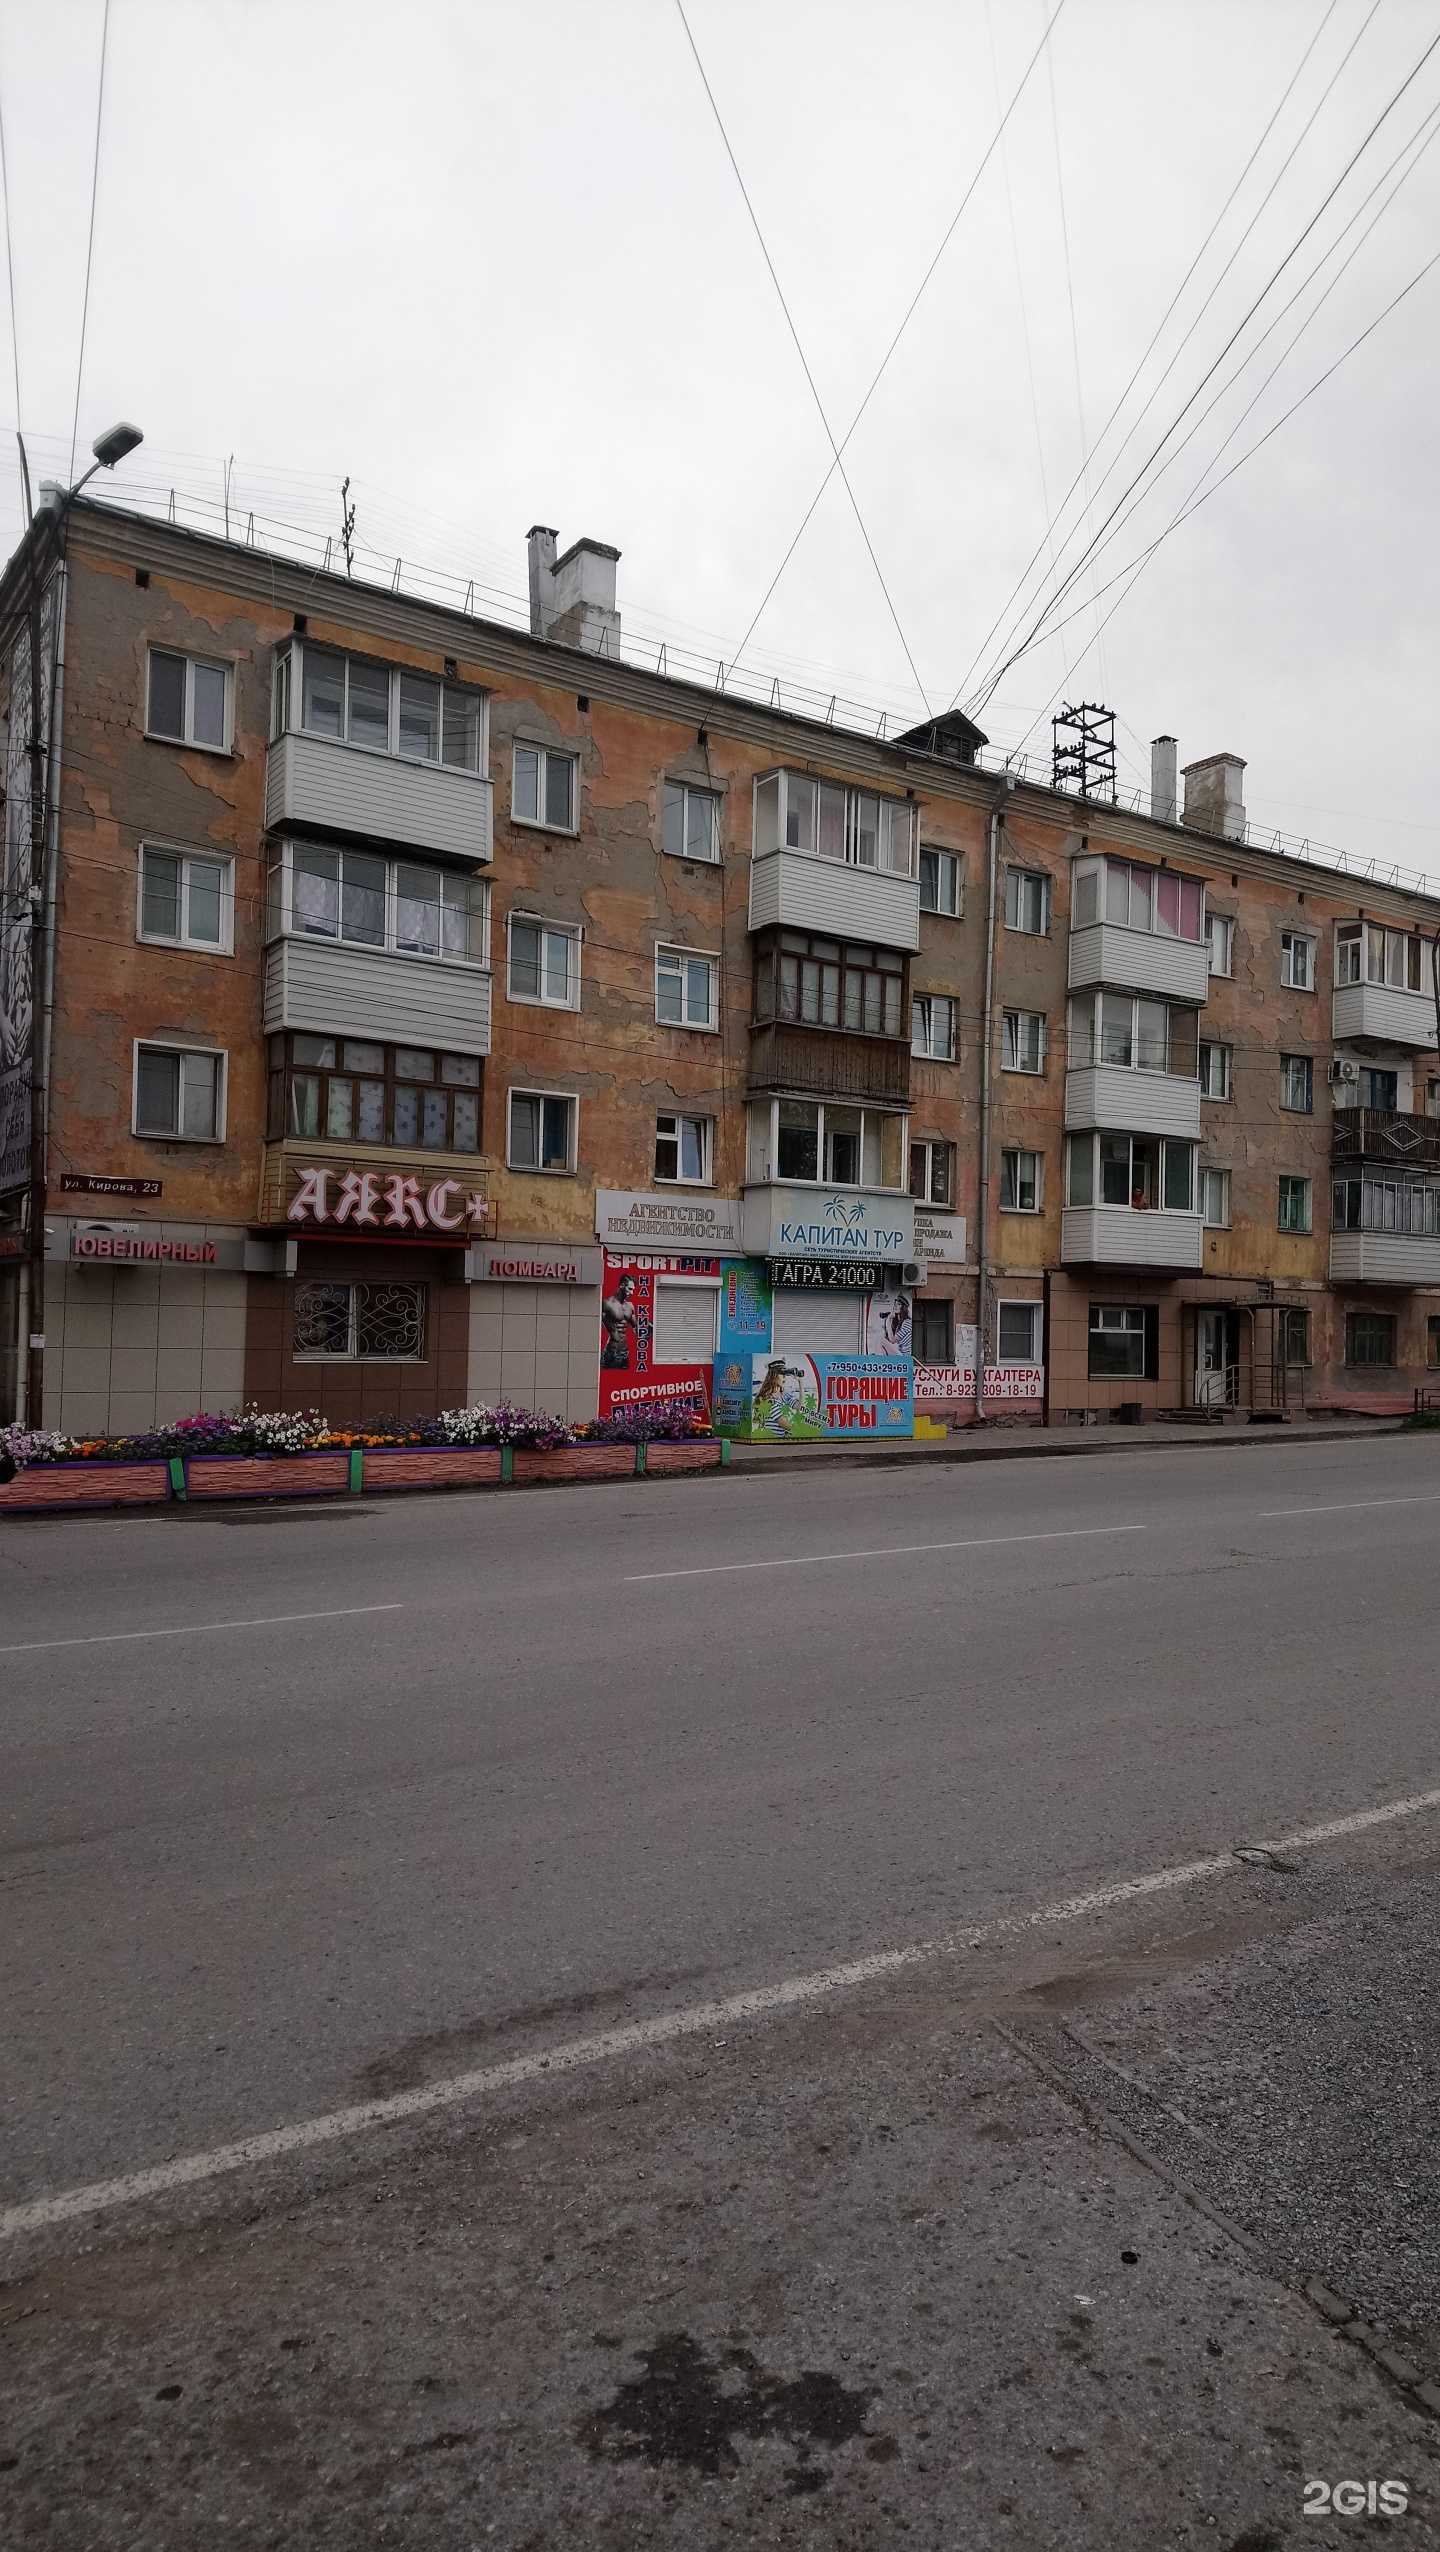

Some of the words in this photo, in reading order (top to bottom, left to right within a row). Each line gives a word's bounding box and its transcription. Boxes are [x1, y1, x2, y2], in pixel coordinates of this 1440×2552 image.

[64, 1178, 82, 1190] ул.
[142, 1182, 159, 1193] 23
[629, 1202, 715, 1222] АГЕНТСТВО
[608, 1217, 734, 1240] НЕДВИЖИМОСТИ
[873, 1230, 904, 1249] ТУР
[74, 1235, 220, 1264] ЮВЕЛИРНЫЙ
[488, 1257, 578, 1281] ЛОМБАРД
[607, 1253, 714, 1273] SPORTPIT
[774, 1262, 824, 1284] ГАГРА
[828, 1265, 875, 1285] 24000
[638, 1275, 649, 1297] НА
[636, 1305, 649, 1372] КИРОВА
[610, 1380, 703, 1402] СПОРТИВНОЕ
[826, 1376, 909, 1403] ГОРЯЩИЕ
[946, 1384, 1037, 1396] 8-923309-18-19
[826, 1403, 877, 1430] ТУРЫ
